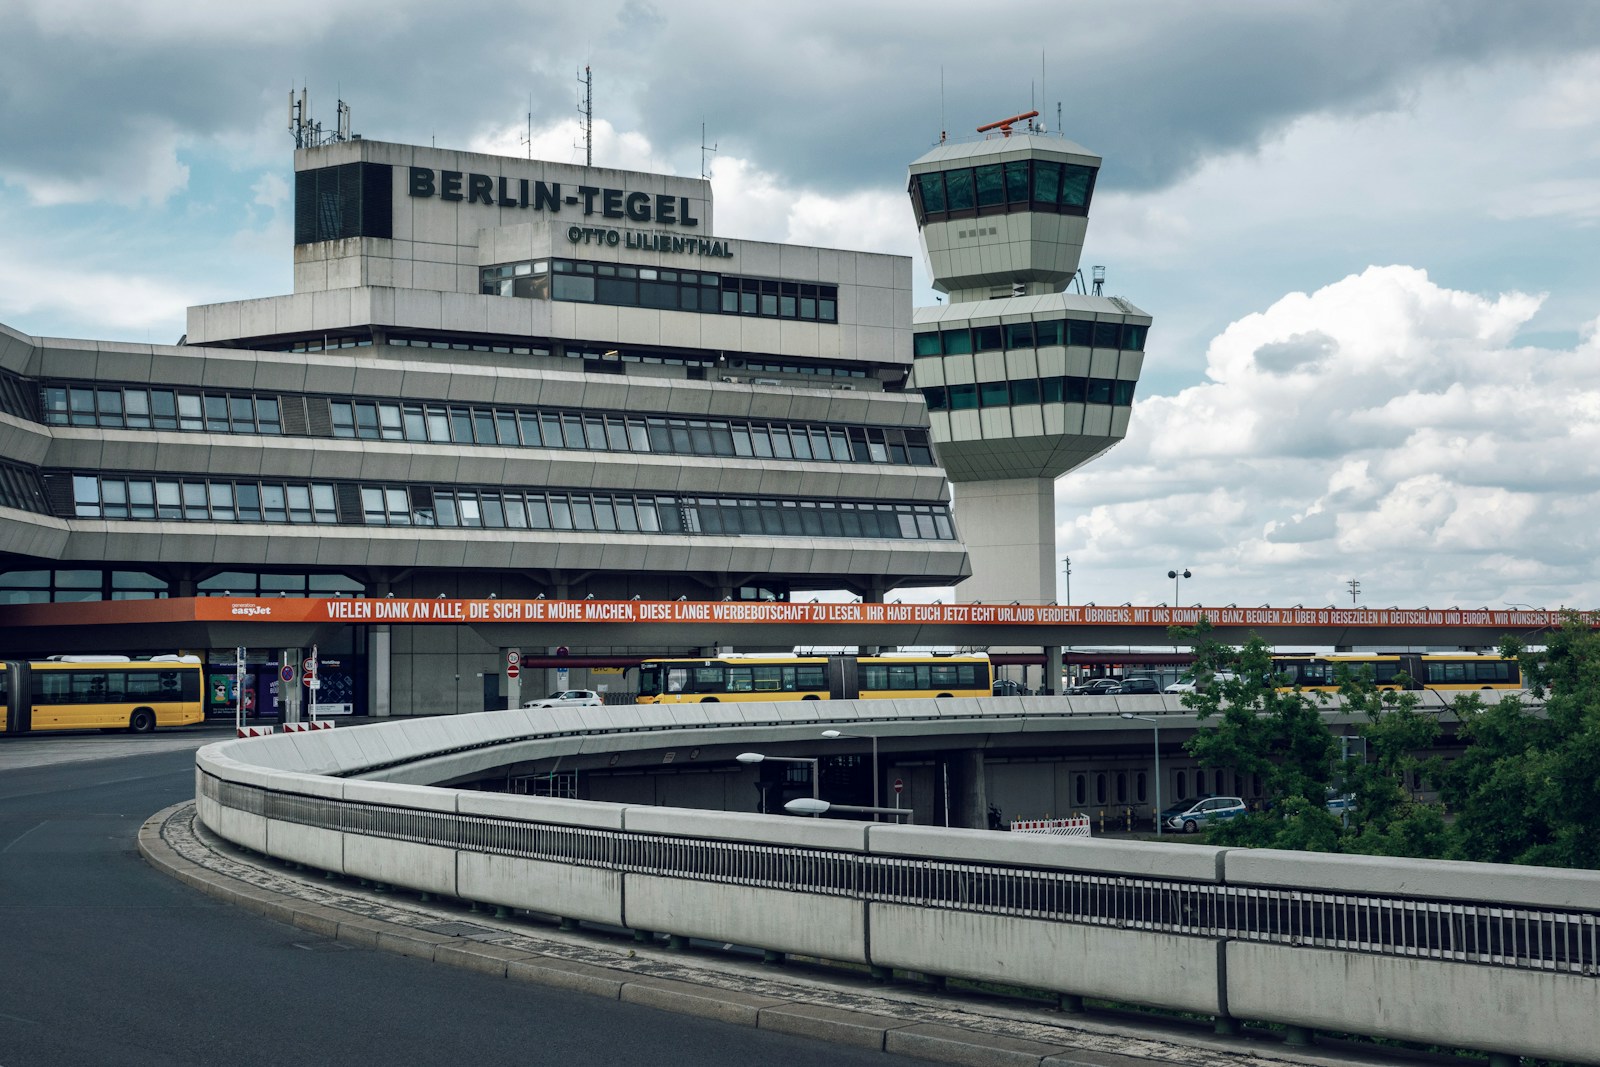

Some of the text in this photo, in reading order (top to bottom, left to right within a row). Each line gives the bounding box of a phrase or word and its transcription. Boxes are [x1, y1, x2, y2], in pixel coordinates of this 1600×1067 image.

[408, 165, 698, 227] BERLIN-TEGEL
[566, 226, 734, 258] OTTO LILIENTHAL
[231, 606, 271, 616] easyJet
[326, 602, 371, 618] VIELEN
[375, 602, 409, 618] DANK
[411, 603, 429, 618] AN
[432, 603, 465, 621] ALLE,
[469, 603, 489, 618] DIE
[492, 603, 520, 618] SICH
[524, 603, 544, 618] DIE
[547, 602, 581, 618] MÜHE
[585, 604, 636, 621] MACHEN,
[639, 604, 671, 619] DIESE
[674, 605, 710, 619] LANGE
[712, 605, 810, 619] WERBEBOTSCHAFT
[812, 605, 826, 620] ZU
[829, 605, 863, 620] LESEN.
[866, 605, 884, 620] IHR
[886, 606, 912, 620] HABT
[914, 606, 940, 620] EUCH
[943, 606, 968, 620] JETZT
[971, 606, 995, 621] ECHT
[997, 607, 1034, 621] URLAUB
[1037, 607, 1082, 621] VERDIENT.
[1085, 607, 1131, 622] ÜBRIGENS:
[1134, 608, 1150, 622] MIT
[1152, 609, 1169, 622] UNS
[1173, 609, 1203, 622] KOMMT
[1222, 609, 1244, 623] GANZ
[1246, 610, 1279, 623] BEQUEM
[1282, 610, 1292, 623] ZU
[1295, 609, 1316, 623] ÜBER
[1318, 610, 1328, 623] 90
[1331, 611, 1378, 624] REISEZIELEN
[1380, 611, 1388, 624] IN
[1391, 611, 1443, 624] DEUTSCHLAND
[1445, 612, 1460, 624] UND
[1463, 612, 1492, 624] EUROPA.
[1494, 612, 1508, 624] WIR
[1510, 611, 1549, 624] WÜNSCHEN
